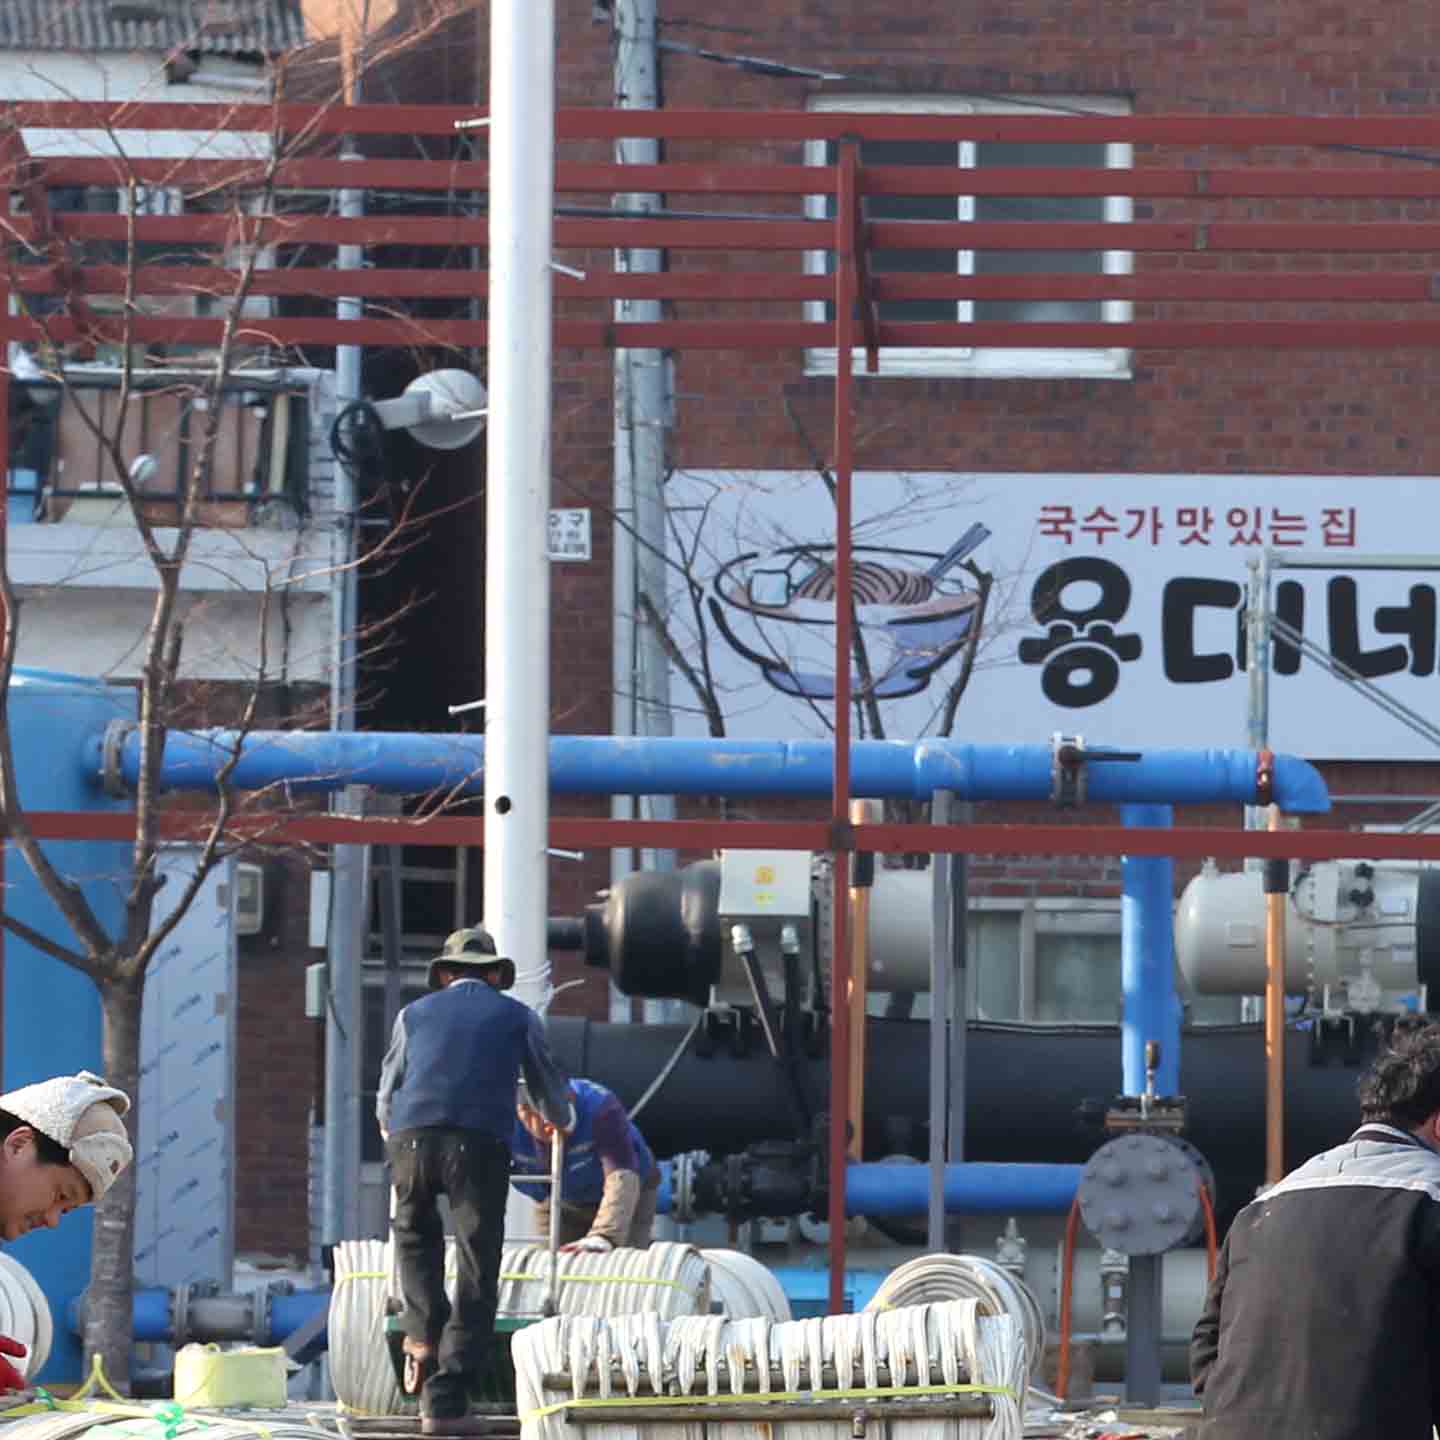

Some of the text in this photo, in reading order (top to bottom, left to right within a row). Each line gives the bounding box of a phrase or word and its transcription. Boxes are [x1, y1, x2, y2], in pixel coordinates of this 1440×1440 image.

[1036, 504, 1356, 548] 국수가 맛 있는 집
